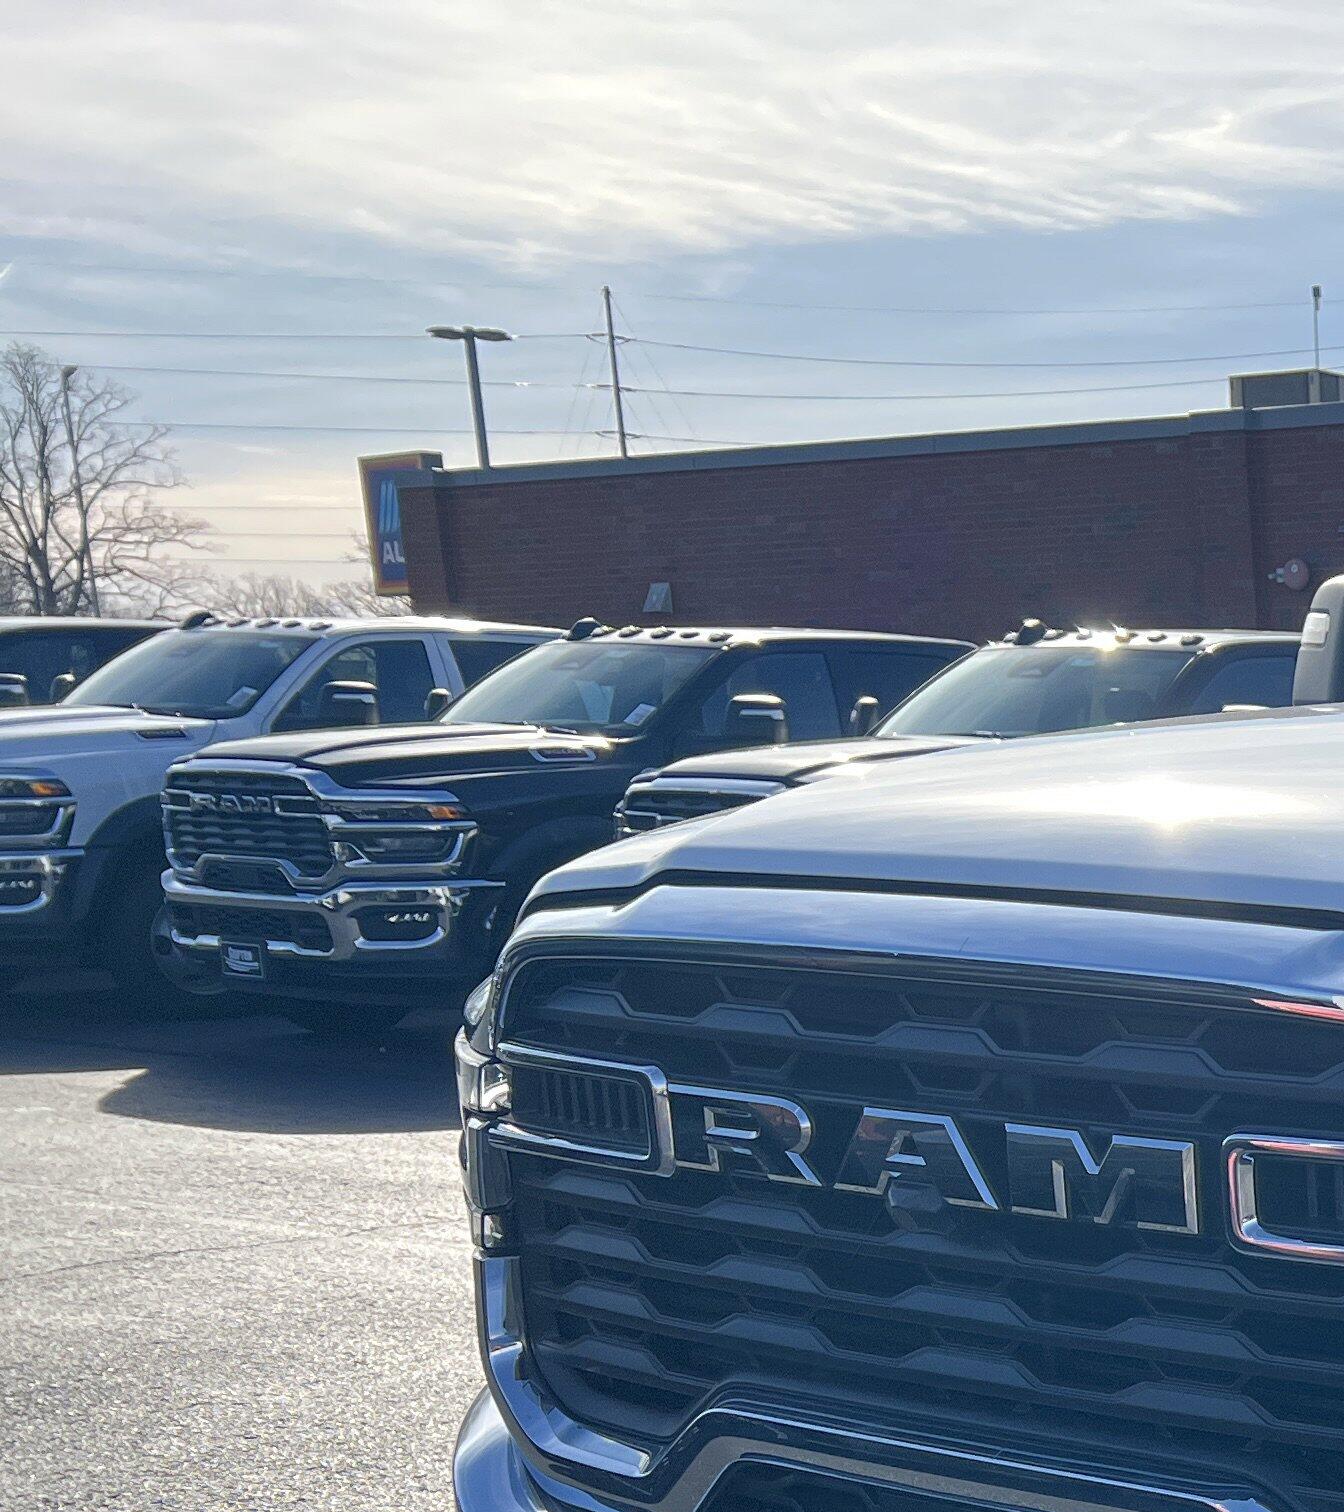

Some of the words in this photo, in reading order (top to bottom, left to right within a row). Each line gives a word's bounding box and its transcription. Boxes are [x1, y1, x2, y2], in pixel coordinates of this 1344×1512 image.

[383, 541, 405, 564] AL
[192, 793, 272, 812] RAM
[669, 1084, 1199, 1234] RAM
